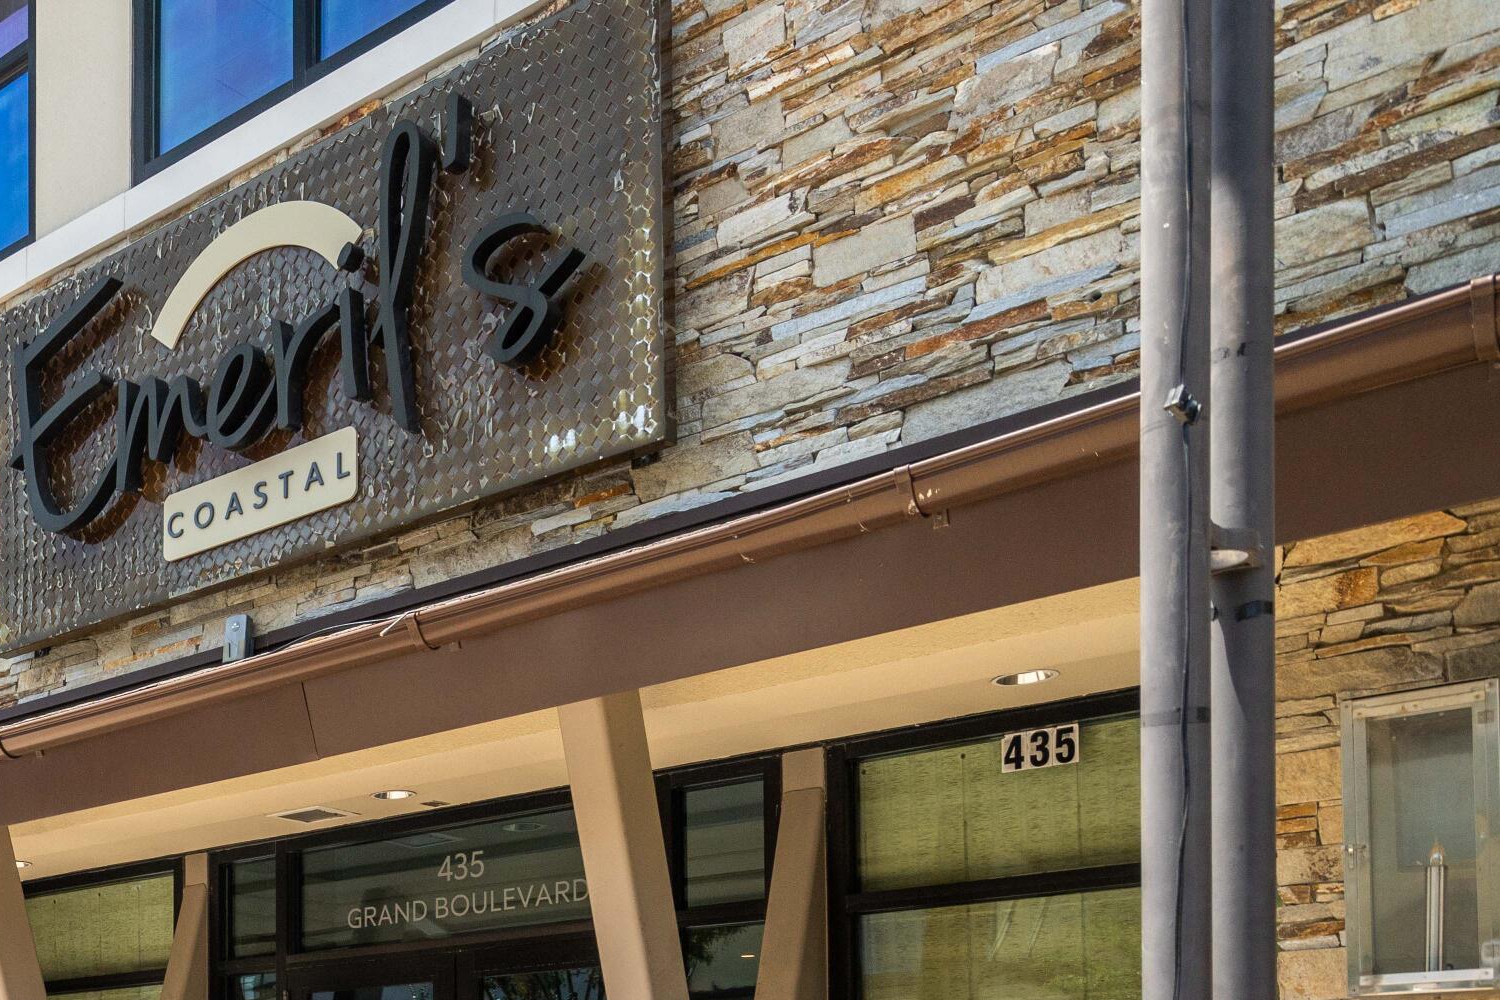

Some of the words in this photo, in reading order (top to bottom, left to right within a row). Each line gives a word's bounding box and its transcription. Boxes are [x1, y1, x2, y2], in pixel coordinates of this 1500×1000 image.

[11, 92, 586, 536] Emeril's
[167, 452, 350, 538] COASTAL
[1004, 727, 1075, 769] 435
[437, 850, 485, 882] 435
[347, 900, 428, 929] GRAND
[435, 878, 589, 920] BOULEVARD
